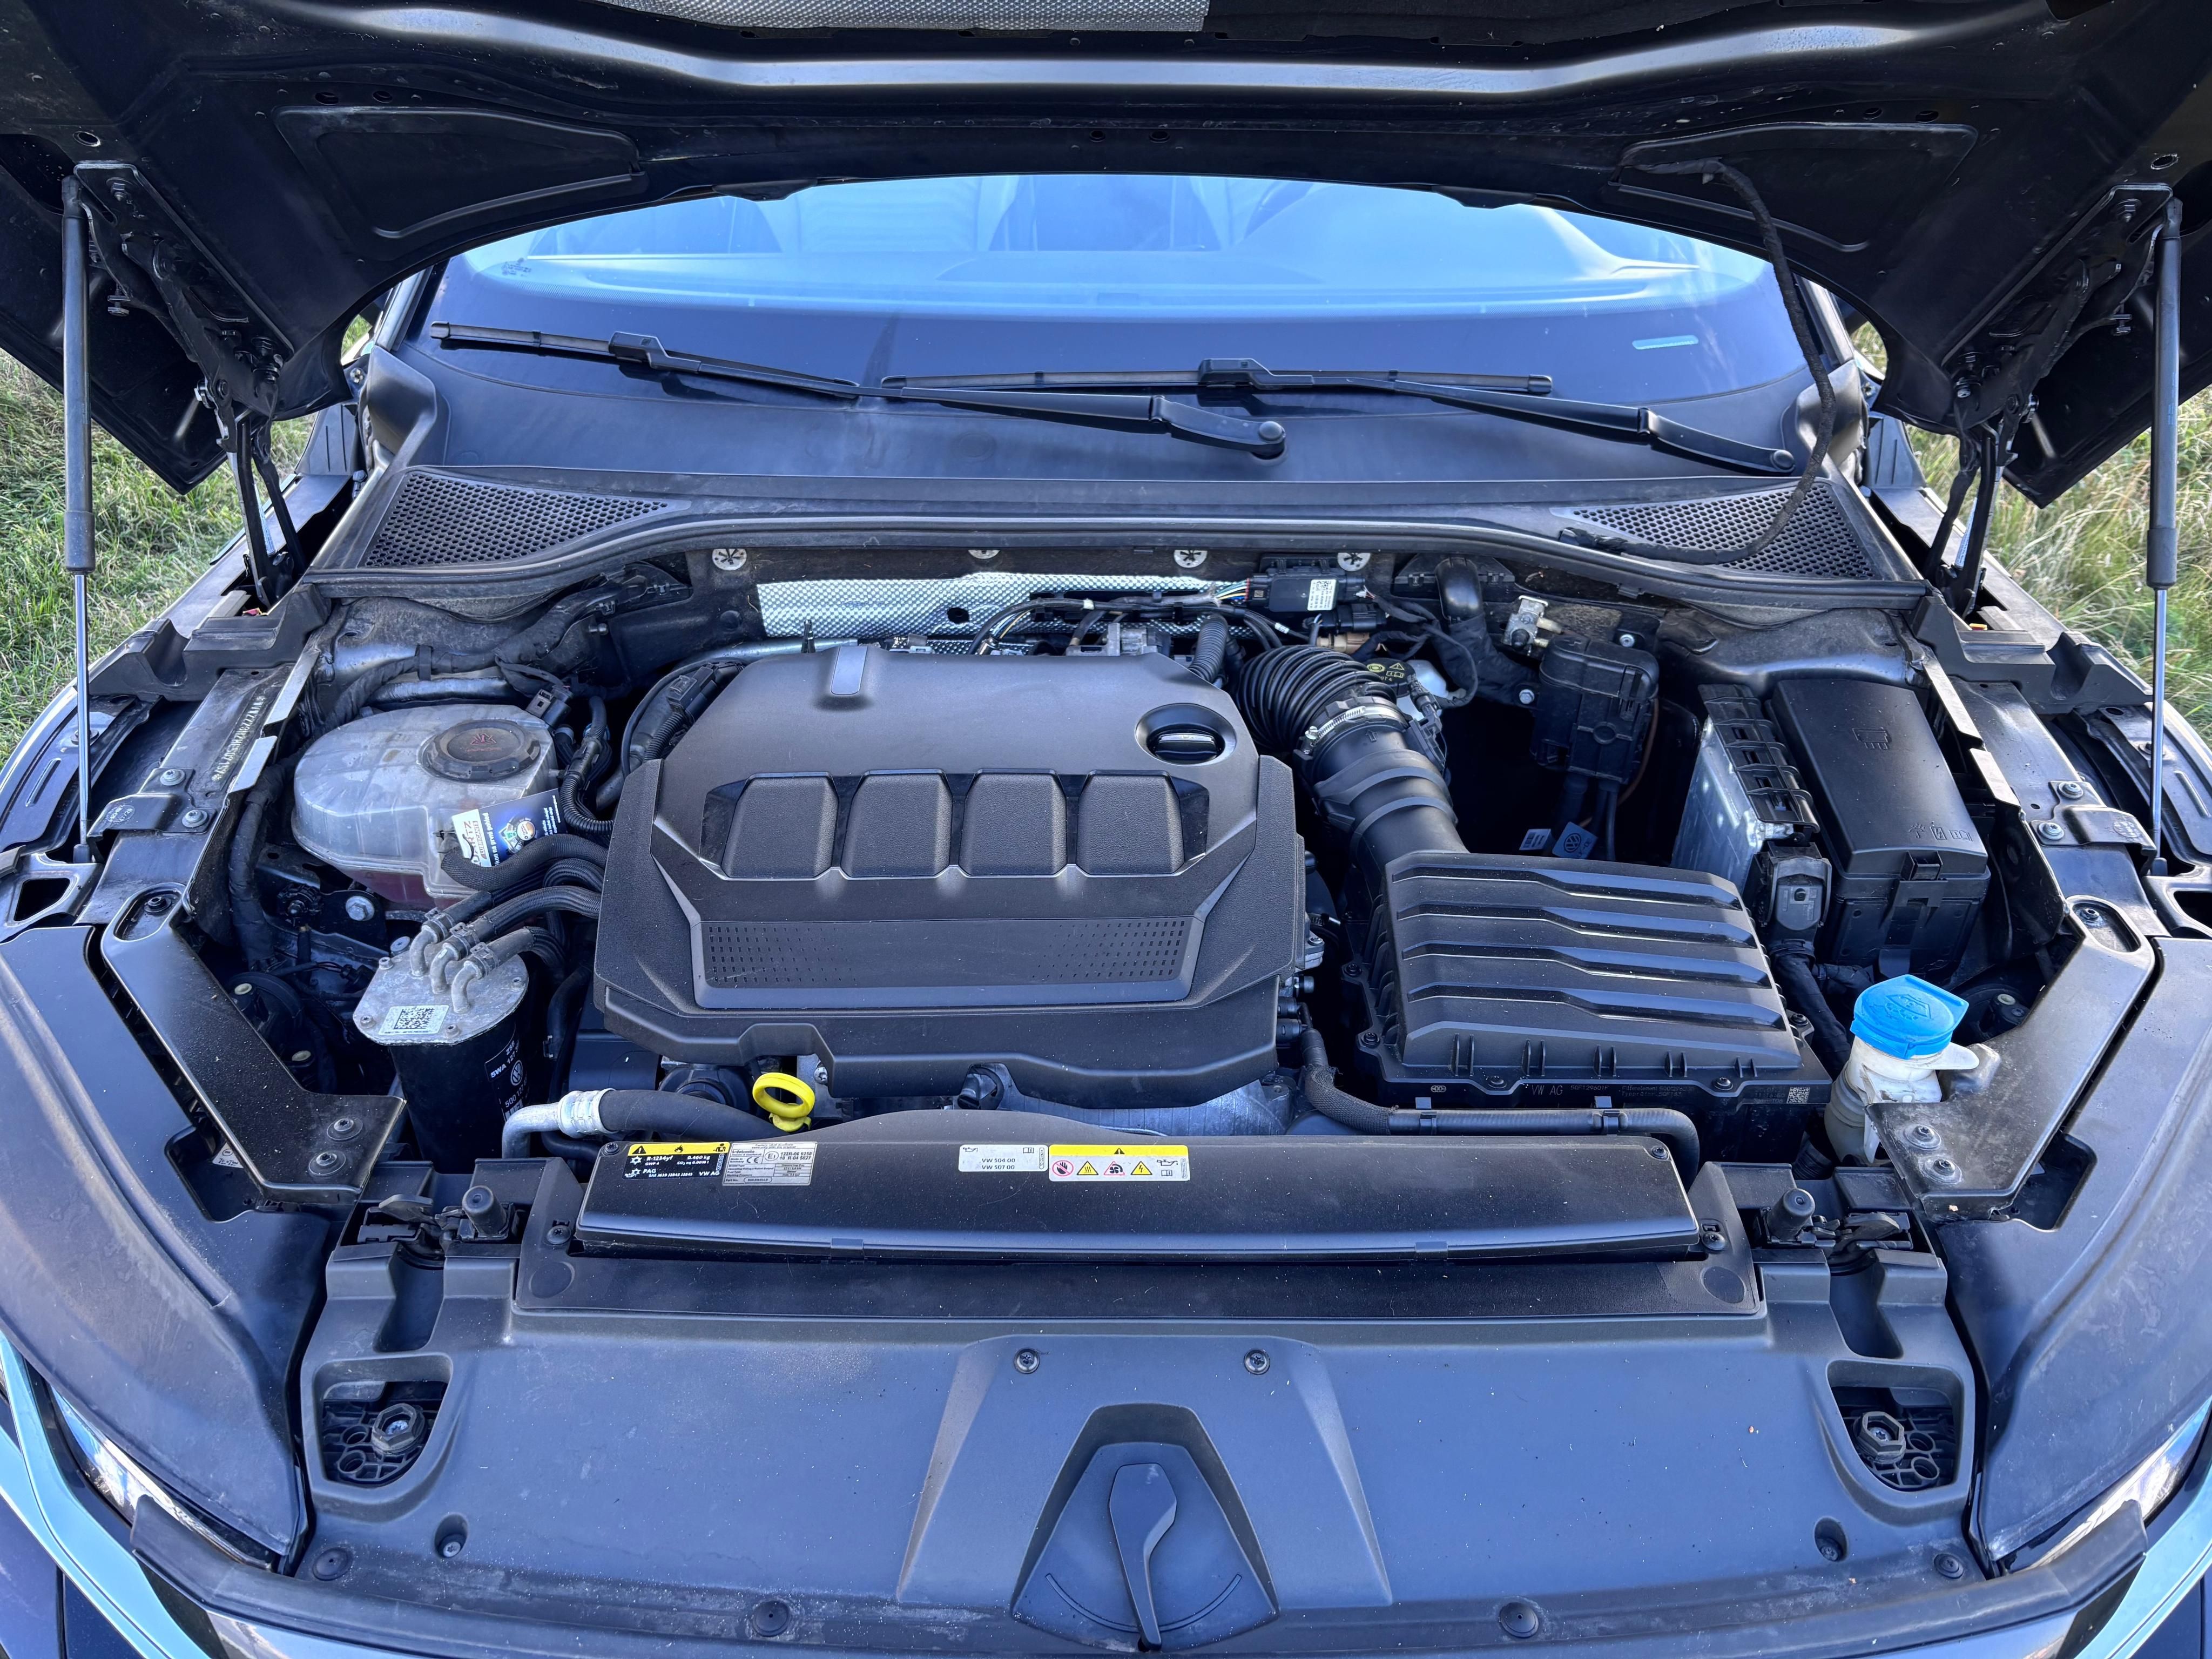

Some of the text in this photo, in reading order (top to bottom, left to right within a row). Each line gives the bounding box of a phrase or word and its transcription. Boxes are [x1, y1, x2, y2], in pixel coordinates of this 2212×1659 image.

[490, 1063, 507, 1078] 5WA
[1532, 1084, 1563, 1096] VW AG
